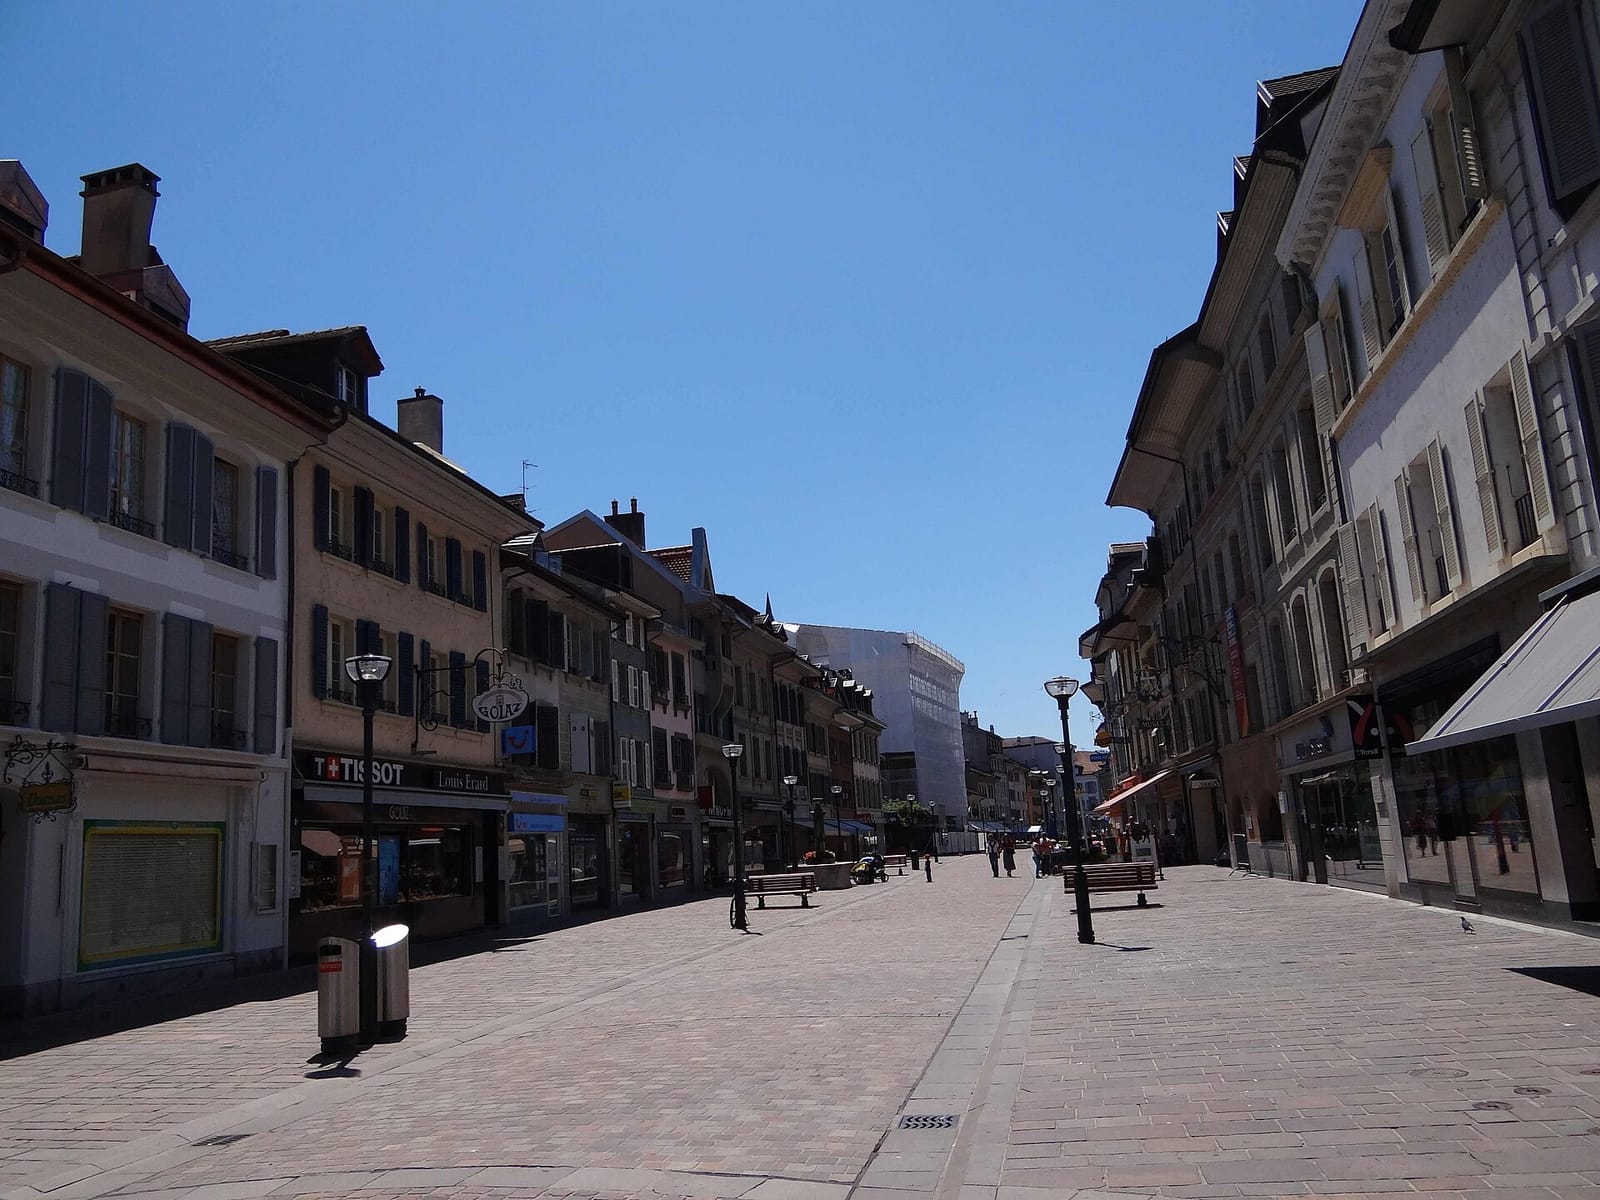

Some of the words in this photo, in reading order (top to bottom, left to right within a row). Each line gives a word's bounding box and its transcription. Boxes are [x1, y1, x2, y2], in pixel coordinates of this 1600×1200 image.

[478, 703, 521, 719] GOLAZ
[340, 757, 404, 785] TISSOT
[439, 770, 464, 789] Louis
[465, 773, 488, 791] Erard
